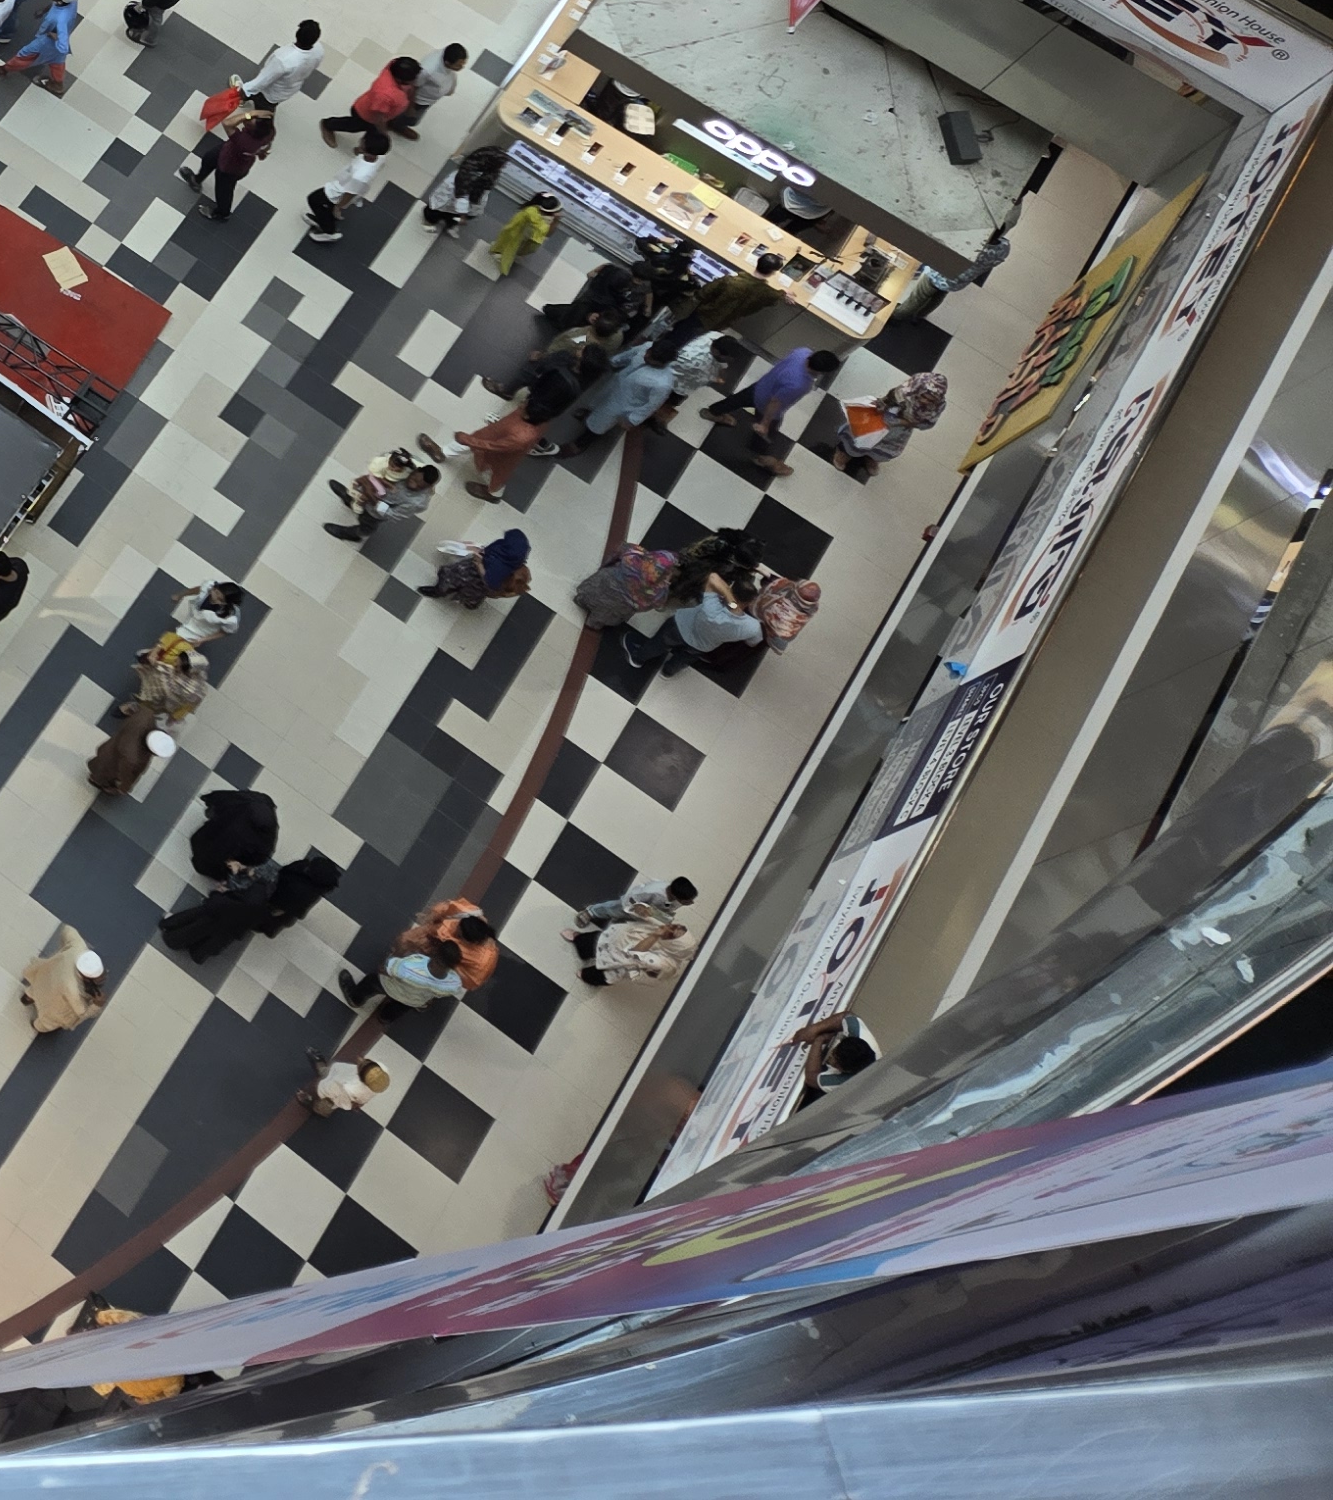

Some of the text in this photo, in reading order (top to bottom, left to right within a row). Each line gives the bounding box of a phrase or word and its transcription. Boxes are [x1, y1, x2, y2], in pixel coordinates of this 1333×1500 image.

[1240, 13, 1287, 45] House
[702, 118, 816, 187] oppo
[1173, 120, 1303, 326] JOTEY
[934, 678, 1009, 794] OUR STORE
[772, 885, 864, 1040] Everyday, Every Occasion
[763, 1064, 801, 1117] Fashion
